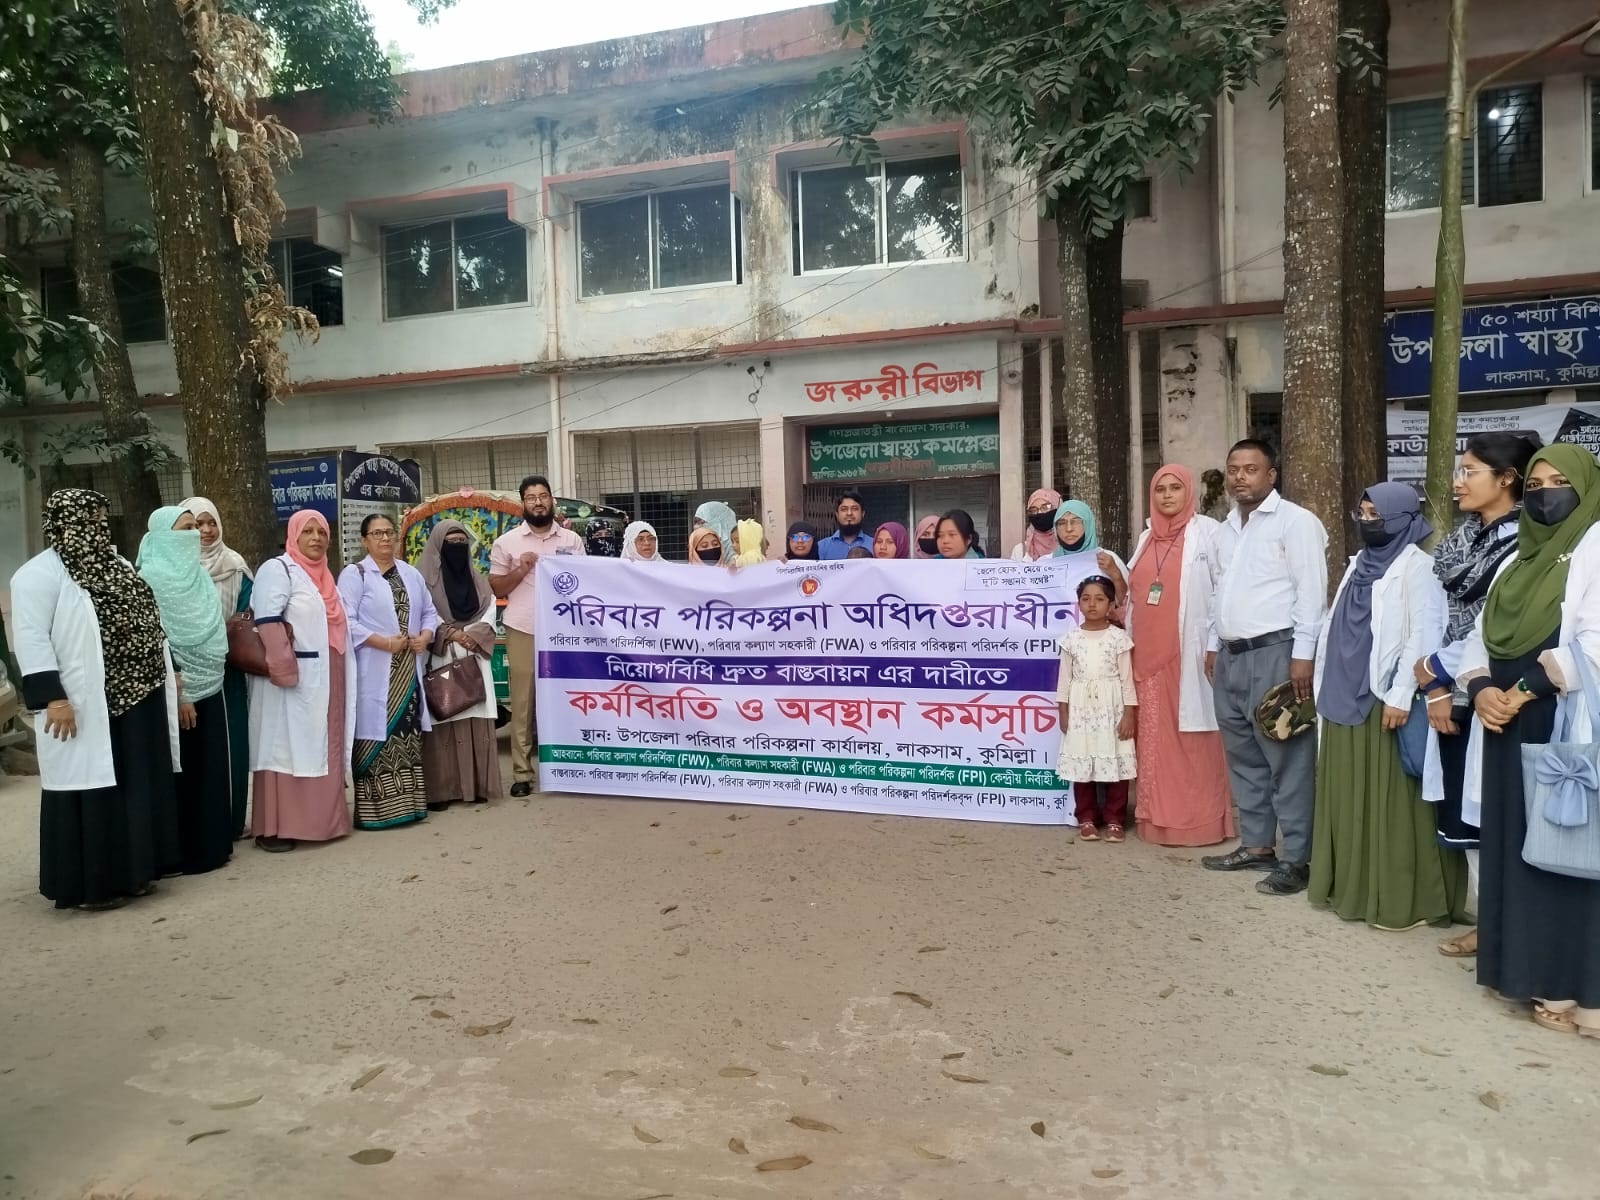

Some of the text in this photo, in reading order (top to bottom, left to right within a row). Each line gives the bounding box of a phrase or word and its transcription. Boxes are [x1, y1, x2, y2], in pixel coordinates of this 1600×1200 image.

[1480, 313, 1508, 327] ৫০
[1563, 302, 1600, 321] বিশি
[1515, 326, 1589, 360] স্বাস্থ্য
[804, 362, 984, 403] জরুরী বিভাগ
[1484, 368, 1550, 384] লাকসাম,
[810, 434, 999, 461] উপজেলা স্বাস্থ্য কমপ্লেক্স
[553, 593, 1080, 632] পরিবার পরিকল্পনা অধিদপ্তরাধীন
[549, 634, 580, 646] পরিবার
[583, 636, 608, 647] কল্যাণ
[610, 635, 656, 650] পরিদর্শিকা
[659, 637, 705, 654] (FWV),
[708, 639, 741, 652] পরিবার
[744, 640, 776, 652] কল্যাণ
[778, 637, 816, 651] সহকারী
[820, 637, 865, 653] (FWA)
[869, 641, 877, 650] ও
[881, 638, 916, 652] পরিবার
[920, 639, 967, 653] পরিকল্পনা
[971, 637, 1019, 652] পরিদর্শক
[605, 655, 1011, 686] নিয়োগবিধি দ্রুত বাস্তবায়ন এর দাবীতে
[565, 682, 1060, 748] কর্মবিরতি ও অবস্থান কর্মসূচি
[580, 728, 611, 744] স্থান:
[617, 725, 679, 746] উপজেলা
[685, 731, 736, 750] পরিবার
[742, 732, 815, 753] পরিকল্পনা
[587, 749, 612, 762] পরিবার
[613, 751, 637, 763] কল্যাণ
[639, 750, 675, 765] পরিদর্শিকা
[716, 756, 742, 769] পরিবার
[744, 757, 769, 770] কল্যাণ
[770, 756, 799, 772] সহকারী
[802, 759, 836, 775] (FWA)
[839, 764, 846, 773] ও
[848, 763, 876, 777] পরিবার
[879, 764, 916, 780] পরিকল্পনা
[919, 766, 955, 782] পরিদর্শক
[957, 769, 987, 786] (FPI)
[990, 770, 1022, 787] কেন্দ্রীয়
[1024, 769, 1054, 787] নির্বাহী
[588, 768, 614, 781] পরিবার
[616, 770, 639, 782] কল্যাণ
[641, 770, 677, 785] পরিদর্শিকা
[718, 775, 745, 789] পরিবার
[747, 777, 771, 790] কল্যাণ
[772, 776, 801, 791] সহকারী
[804, 780, 838, 796] (FWA)
[841, 785, 848, 794] ও
[850, 783, 878, 797] পরিবার
[880, 785, 918, 800] পরিকল্পনা
[976, 791, 1006, 808] (FPI)
